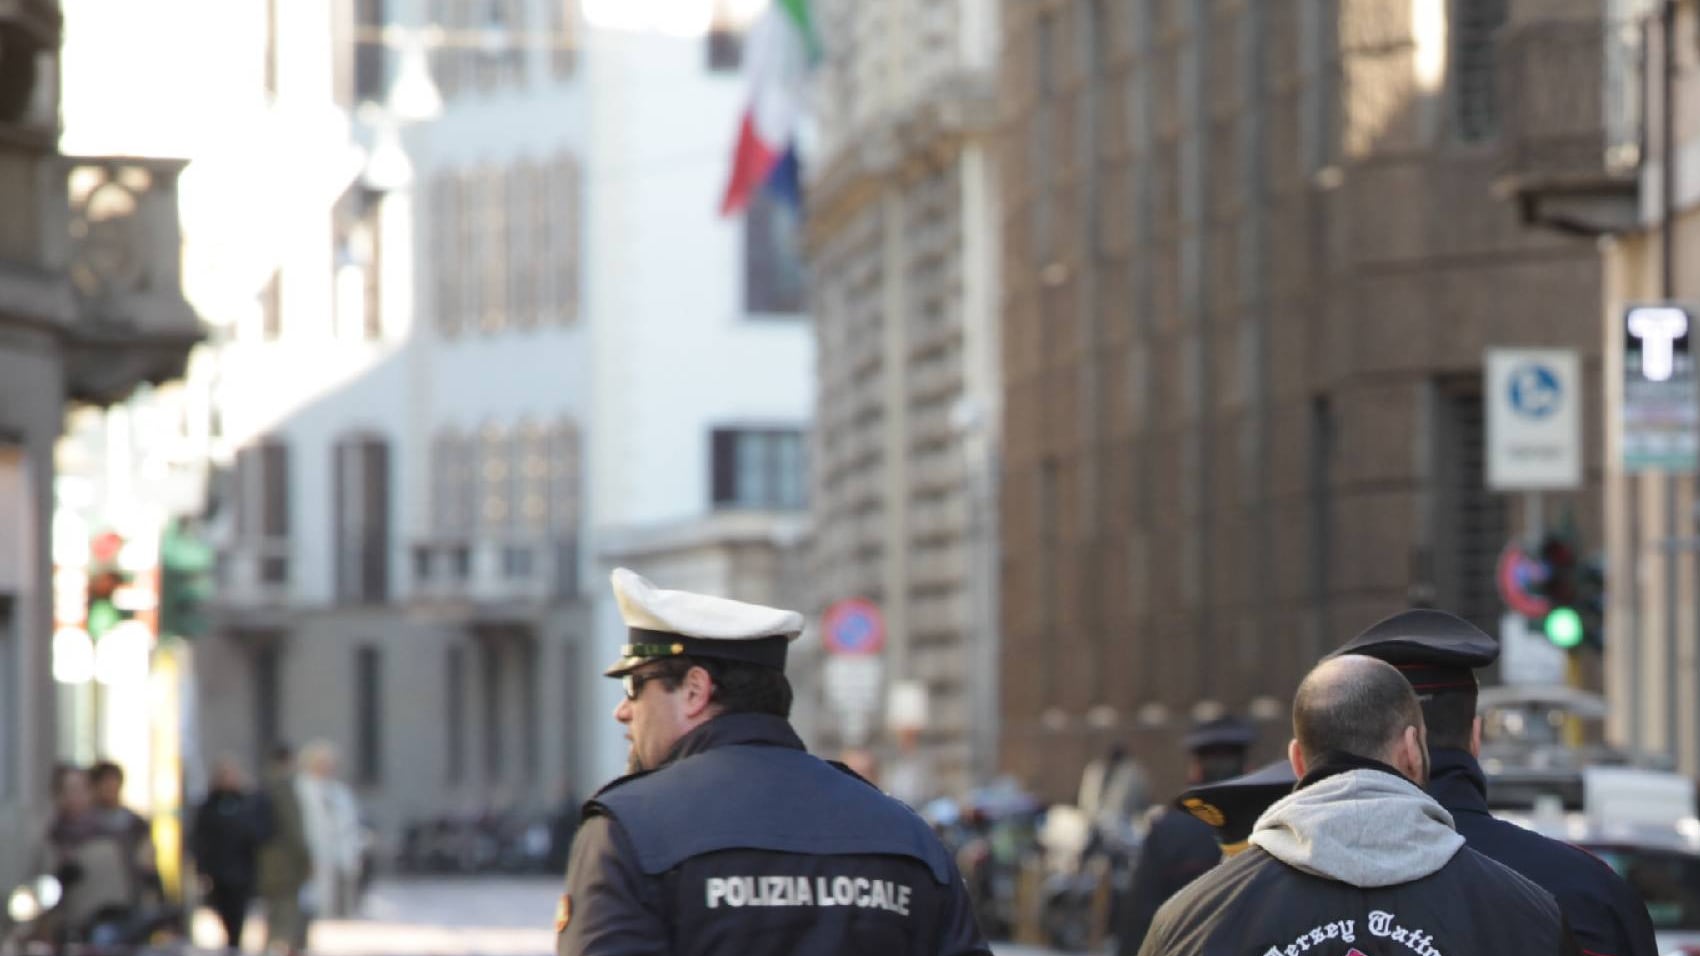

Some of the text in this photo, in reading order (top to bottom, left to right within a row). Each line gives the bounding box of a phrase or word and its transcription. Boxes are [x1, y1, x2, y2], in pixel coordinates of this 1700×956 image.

[1627, 308, 1688, 381] T
[706, 875, 913, 916] POLIZIA LOCALE
